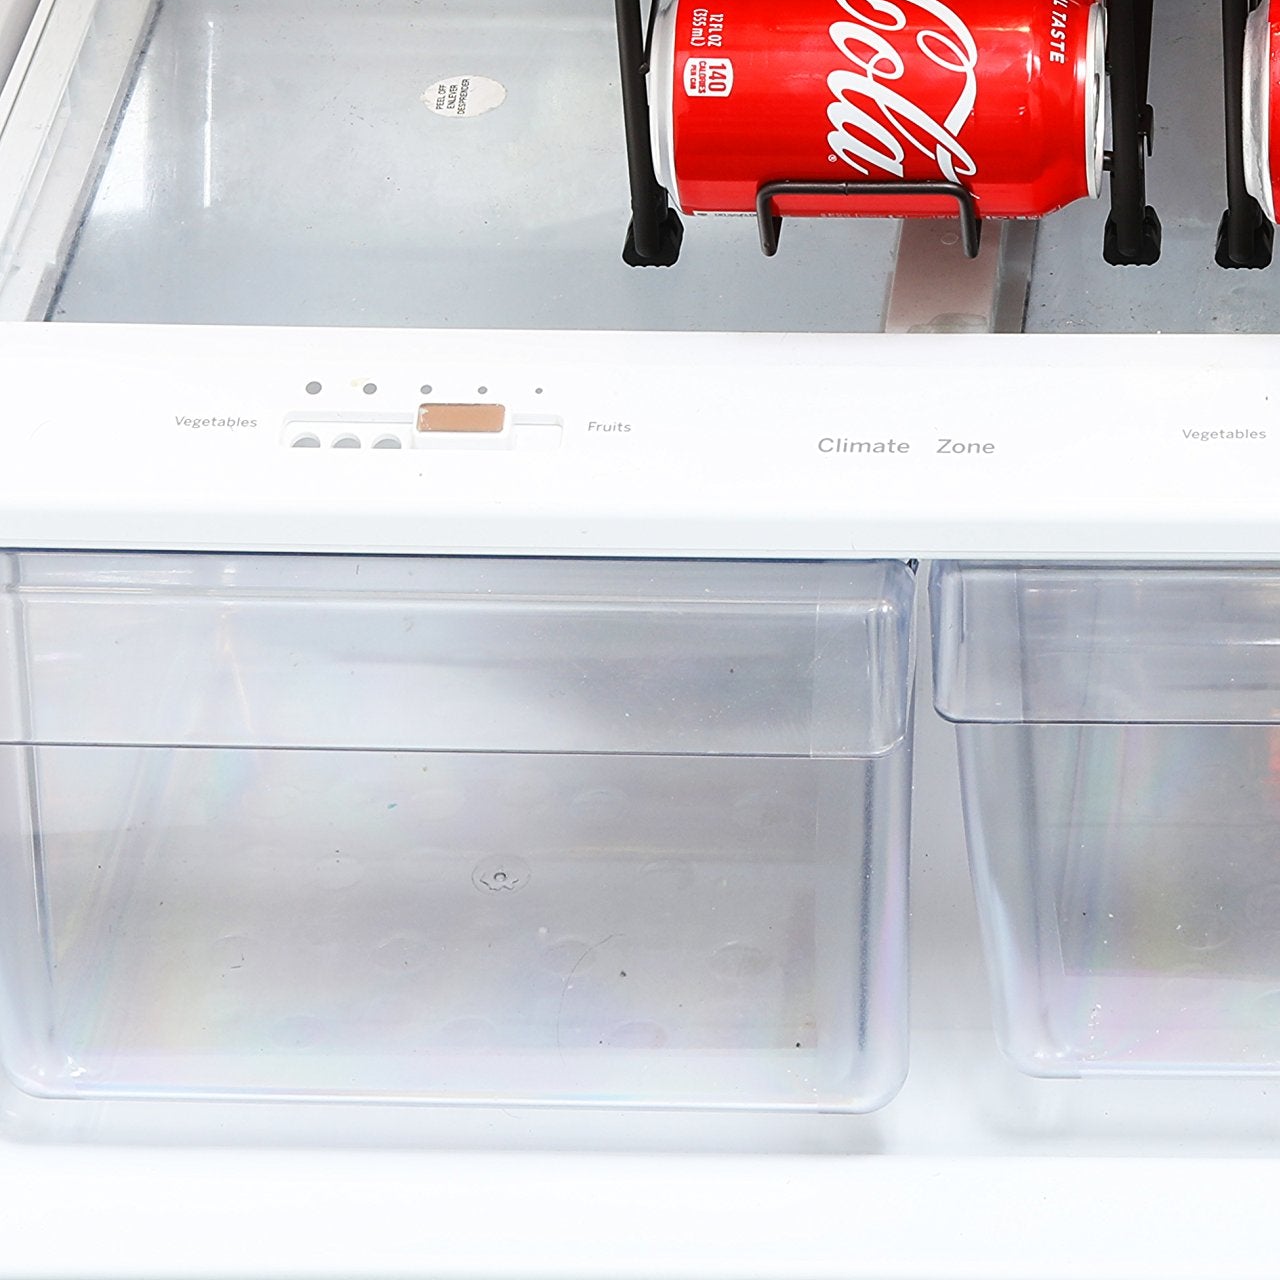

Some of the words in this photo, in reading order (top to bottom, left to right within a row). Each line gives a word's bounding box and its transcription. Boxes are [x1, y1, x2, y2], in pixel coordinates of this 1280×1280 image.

[692, 8, 708, 27] (355
[710, 14, 724, 22] 12
[708, 24, 723, 32] FL
[690, 28, 706, 47] mL)
[708, 34, 722, 46] OZ
[1049, 11, 1067, 64] TASTE
[698, 60, 706, 94] CALORIES
[708, 63, 727, 92] 140
[438, 84, 446, 95] OFF
[436, 96, 446, 110] PEEL
[174, 415, 258, 431] Vegetables
[587, 421, 632, 433] Fruits
[1181, 426, 1268, 442] Vegetables
[817, 437, 910, 454] Climate
[936, 438, 996, 454] Zone
